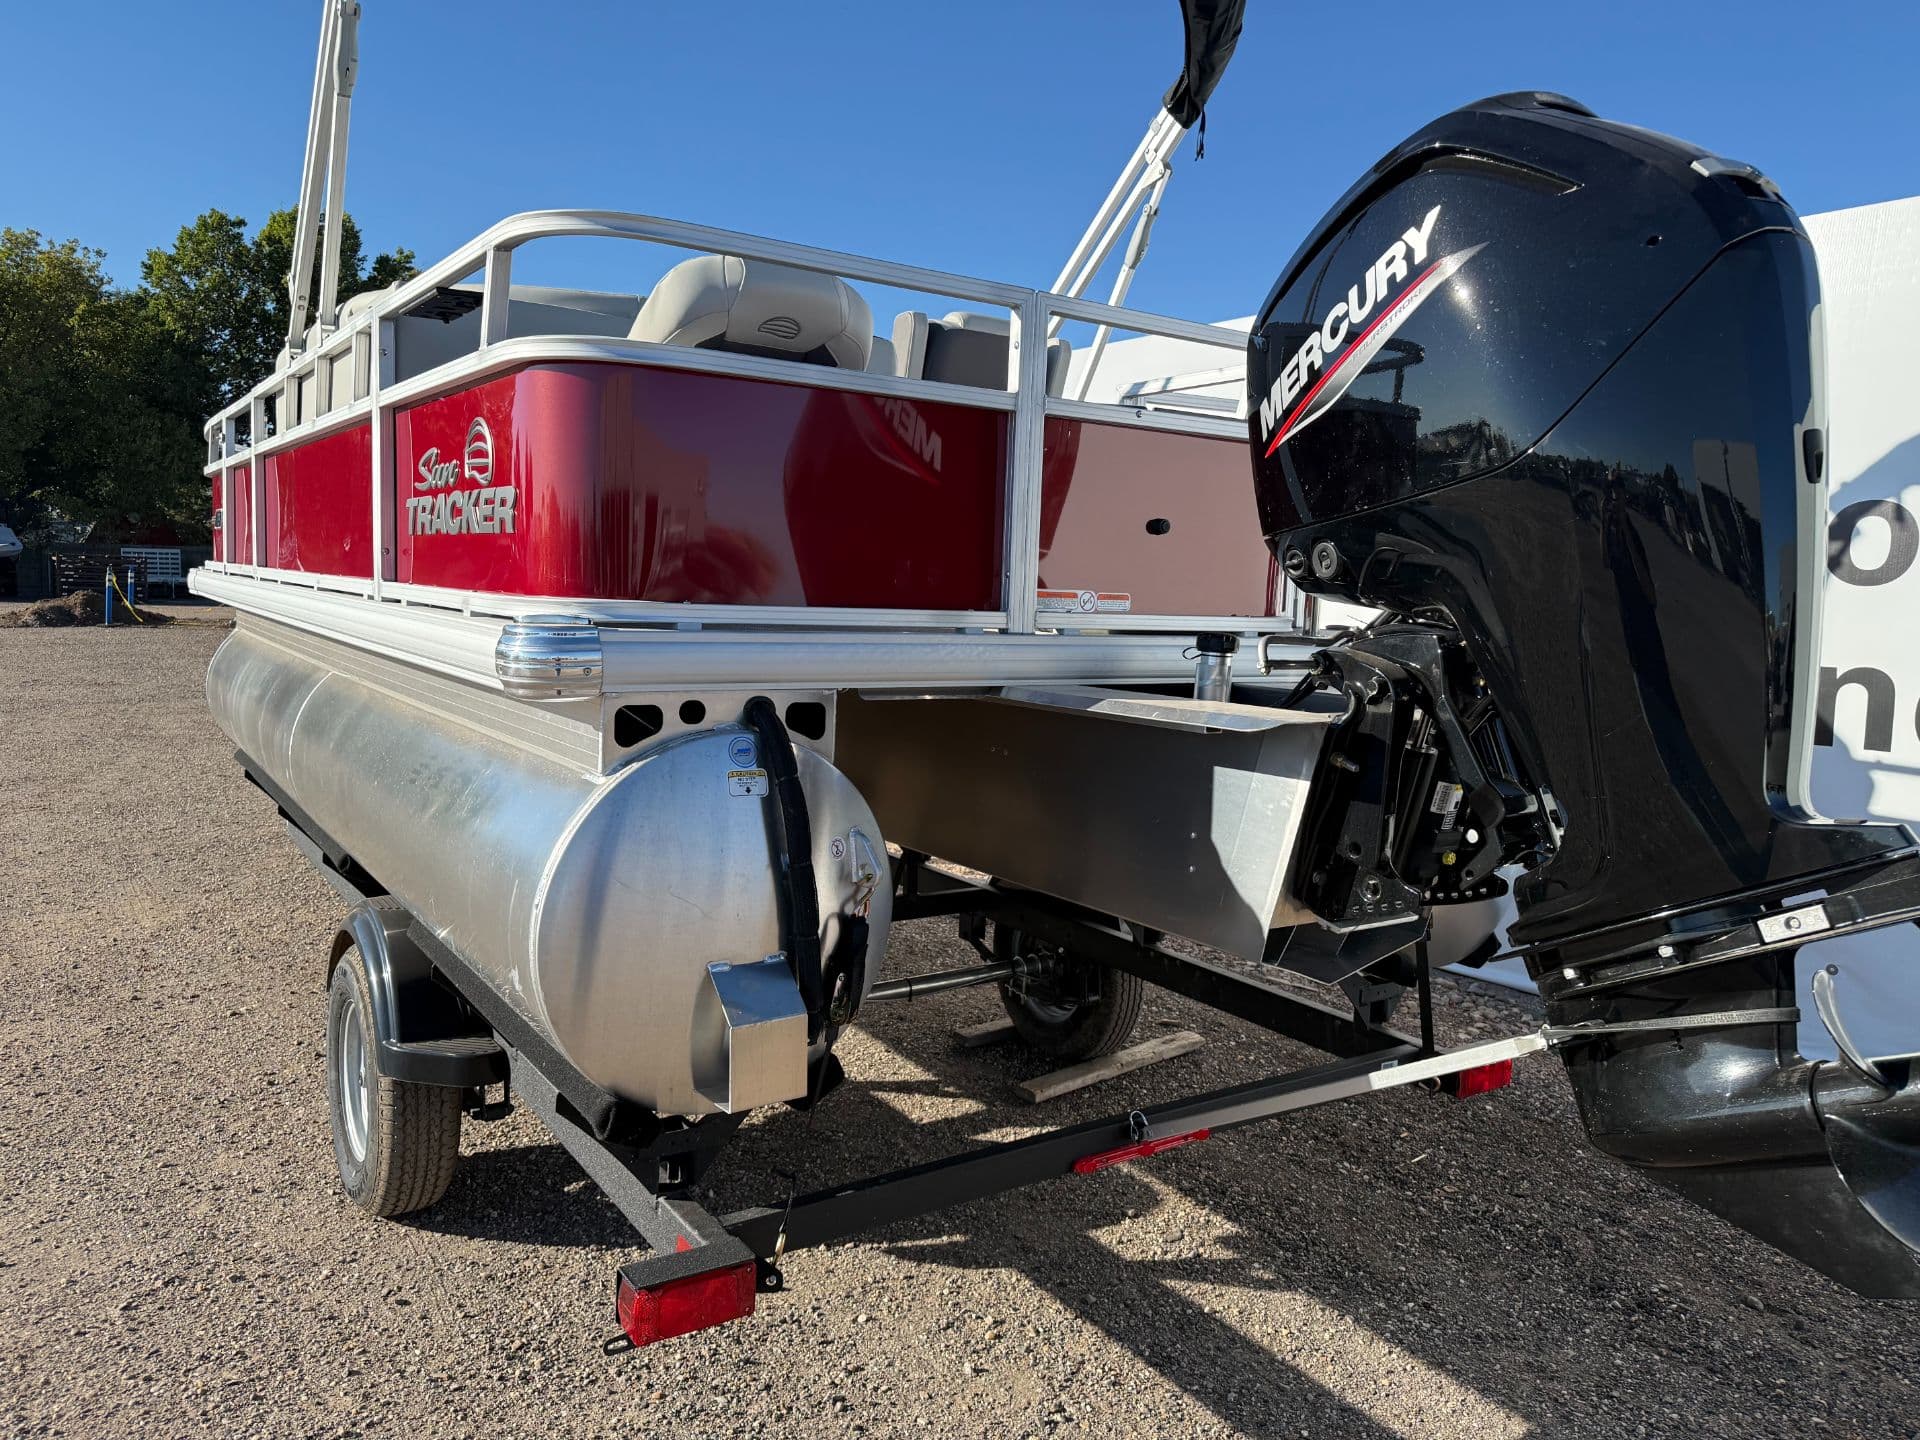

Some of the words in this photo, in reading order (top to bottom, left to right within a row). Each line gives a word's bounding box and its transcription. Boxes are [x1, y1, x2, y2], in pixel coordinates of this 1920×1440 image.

[1259, 204, 1442, 443] MERCURY
[414, 446, 461, 491] Sun
[405, 485, 519, 536] TRACKER
